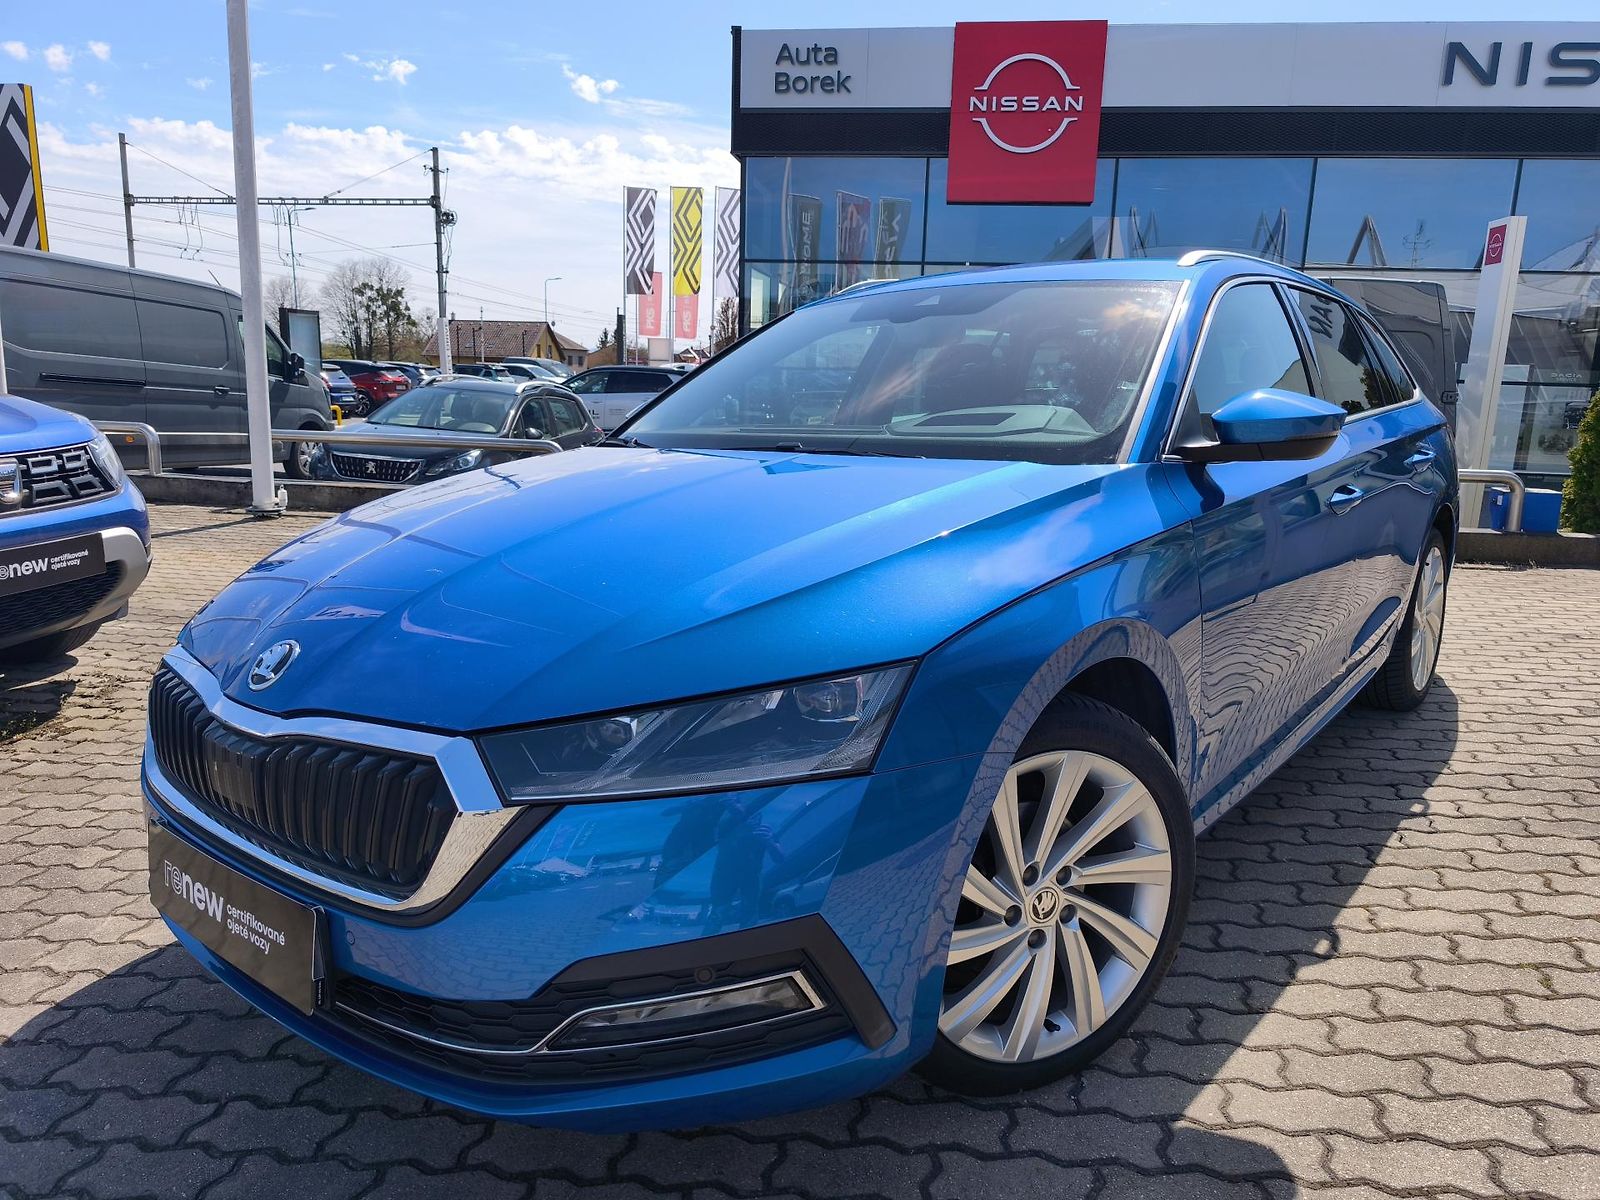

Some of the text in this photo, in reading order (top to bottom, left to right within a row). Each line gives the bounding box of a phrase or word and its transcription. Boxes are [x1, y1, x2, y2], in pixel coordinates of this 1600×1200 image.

[775, 42, 839, 66] Auta
[774, 70, 852, 94] Borek
[968, 95, 1084, 113] NISSAN
[51, 549, 89, 564] certifikované
[51, 558, 81, 571] ojeté vozy
[164, 860, 286, 946] renew certifikované
[227, 918, 271, 954] ojeté vozy
